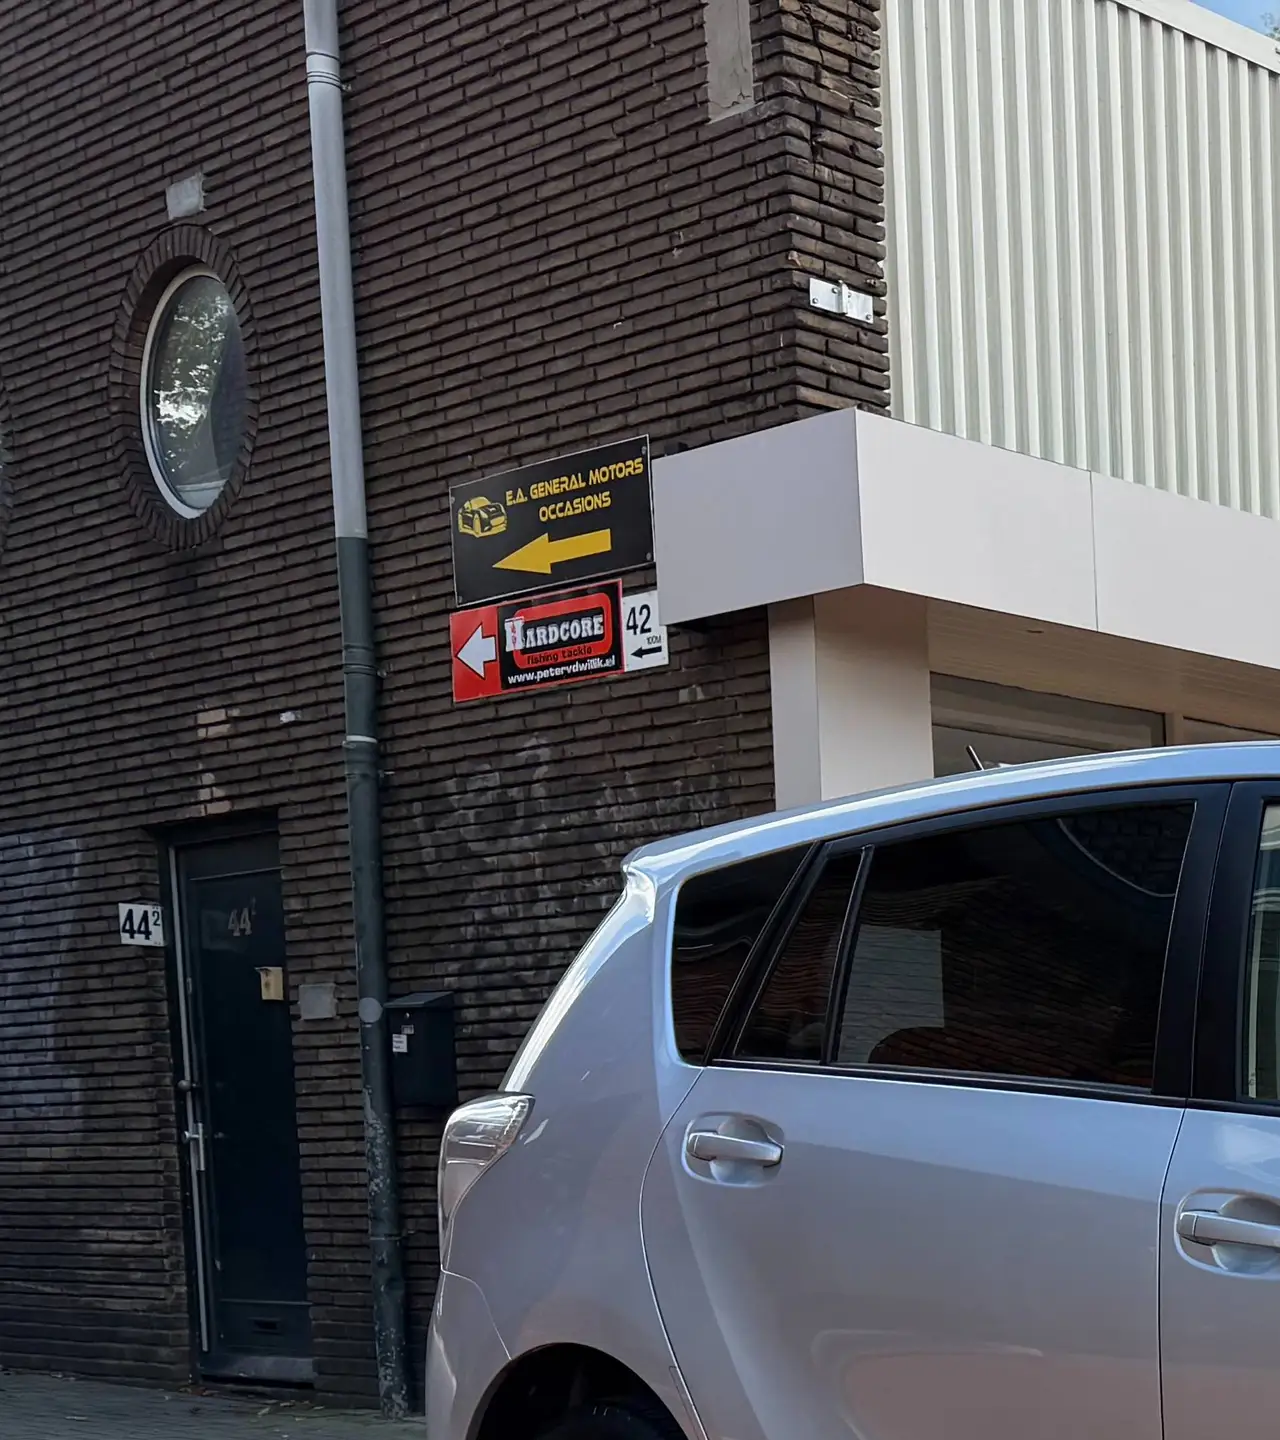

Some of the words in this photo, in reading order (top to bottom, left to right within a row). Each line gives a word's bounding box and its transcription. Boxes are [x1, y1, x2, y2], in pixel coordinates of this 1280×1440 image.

[505, 489, 528, 506] E.A.
[530, 472, 586, 499] GENERAL
[588, 457, 644, 485] MOTORS
[538, 491, 612, 522] OCCASIONS
[504, 613, 604, 652] HARDCORE
[626, 604, 652, 636] 42
[526, 651, 559, 665] fishing
[562, 645, 593, 658] tackle
